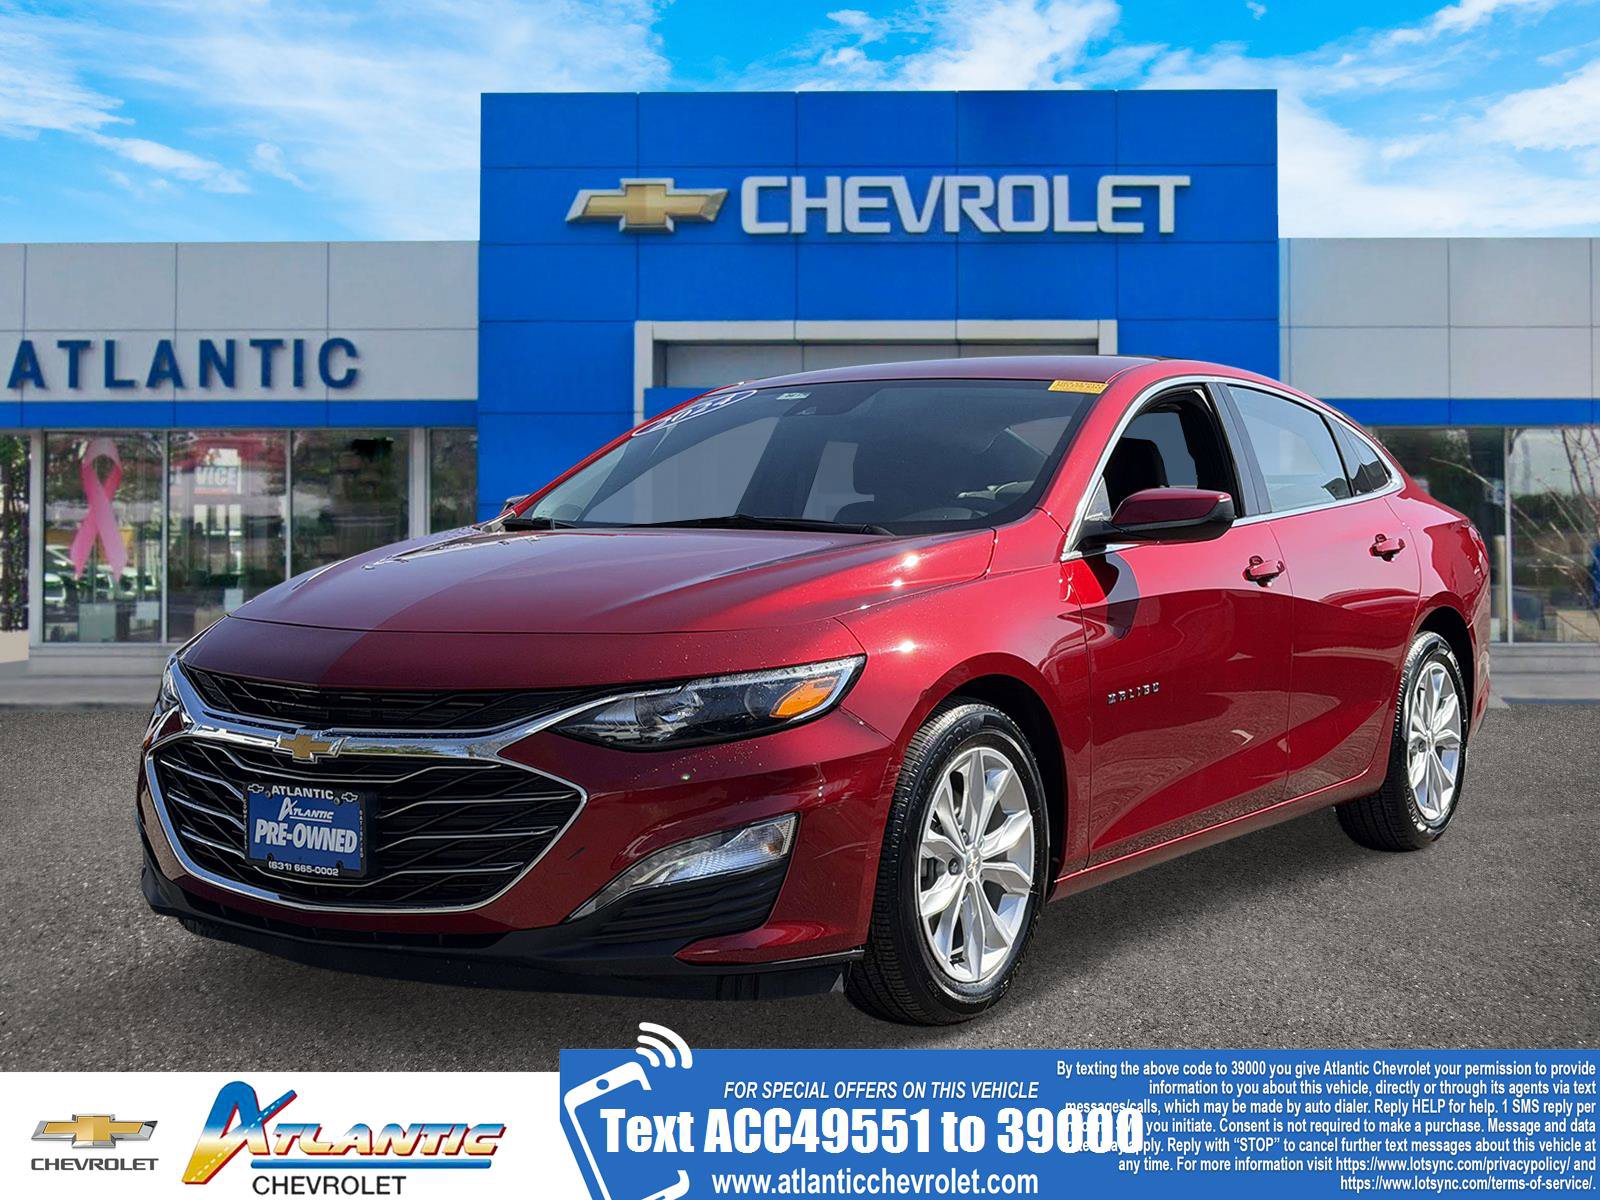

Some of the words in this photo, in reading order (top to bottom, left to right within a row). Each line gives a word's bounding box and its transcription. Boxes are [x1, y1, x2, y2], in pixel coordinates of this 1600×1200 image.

[742, 175, 1191, 234] CHEVROLET
[7, 338, 360, 389] ATLANTIC
[271, 785, 334, 800] ATLANTIC
[254, 819, 358, 854] PRE-OWNED
[268, 860, 292, 872] (631)
